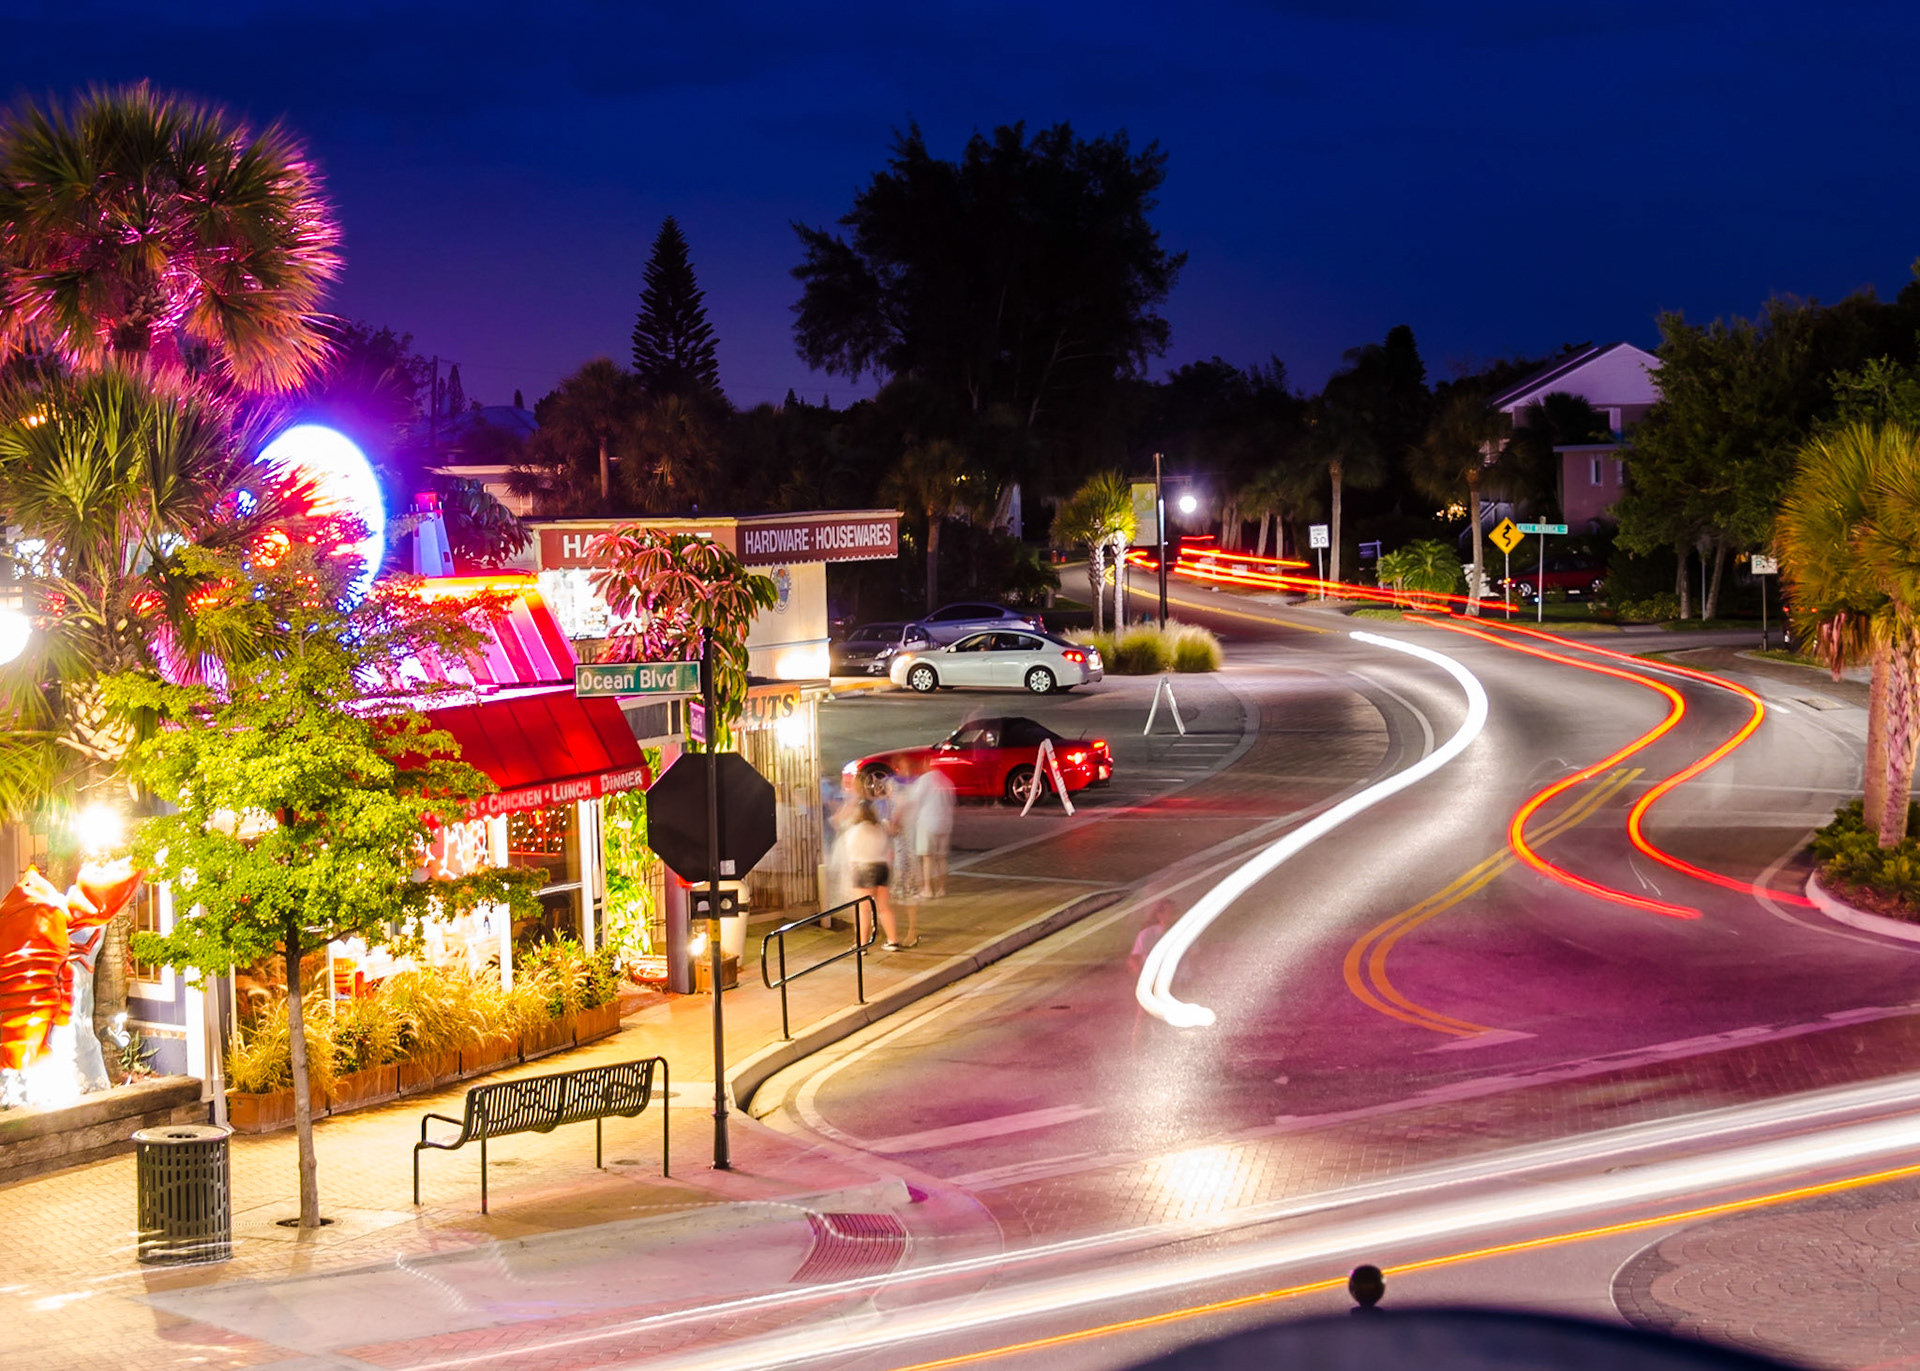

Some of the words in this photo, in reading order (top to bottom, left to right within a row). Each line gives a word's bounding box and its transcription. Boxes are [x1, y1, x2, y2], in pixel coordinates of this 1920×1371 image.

[745, 527, 809, 554] HARDWARE
[815, 523, 891, 549] HOUSEWARES
[1313, 536, 1326, 545] 30
[580, 671, 634, 690] Ocean
[640, 669, 677, 688] Blvd
[488, 789, 543, 813] CHICKEN
[552, 780, 591, 802] LUNCH
[600, 770, 643, 792] DINNER
